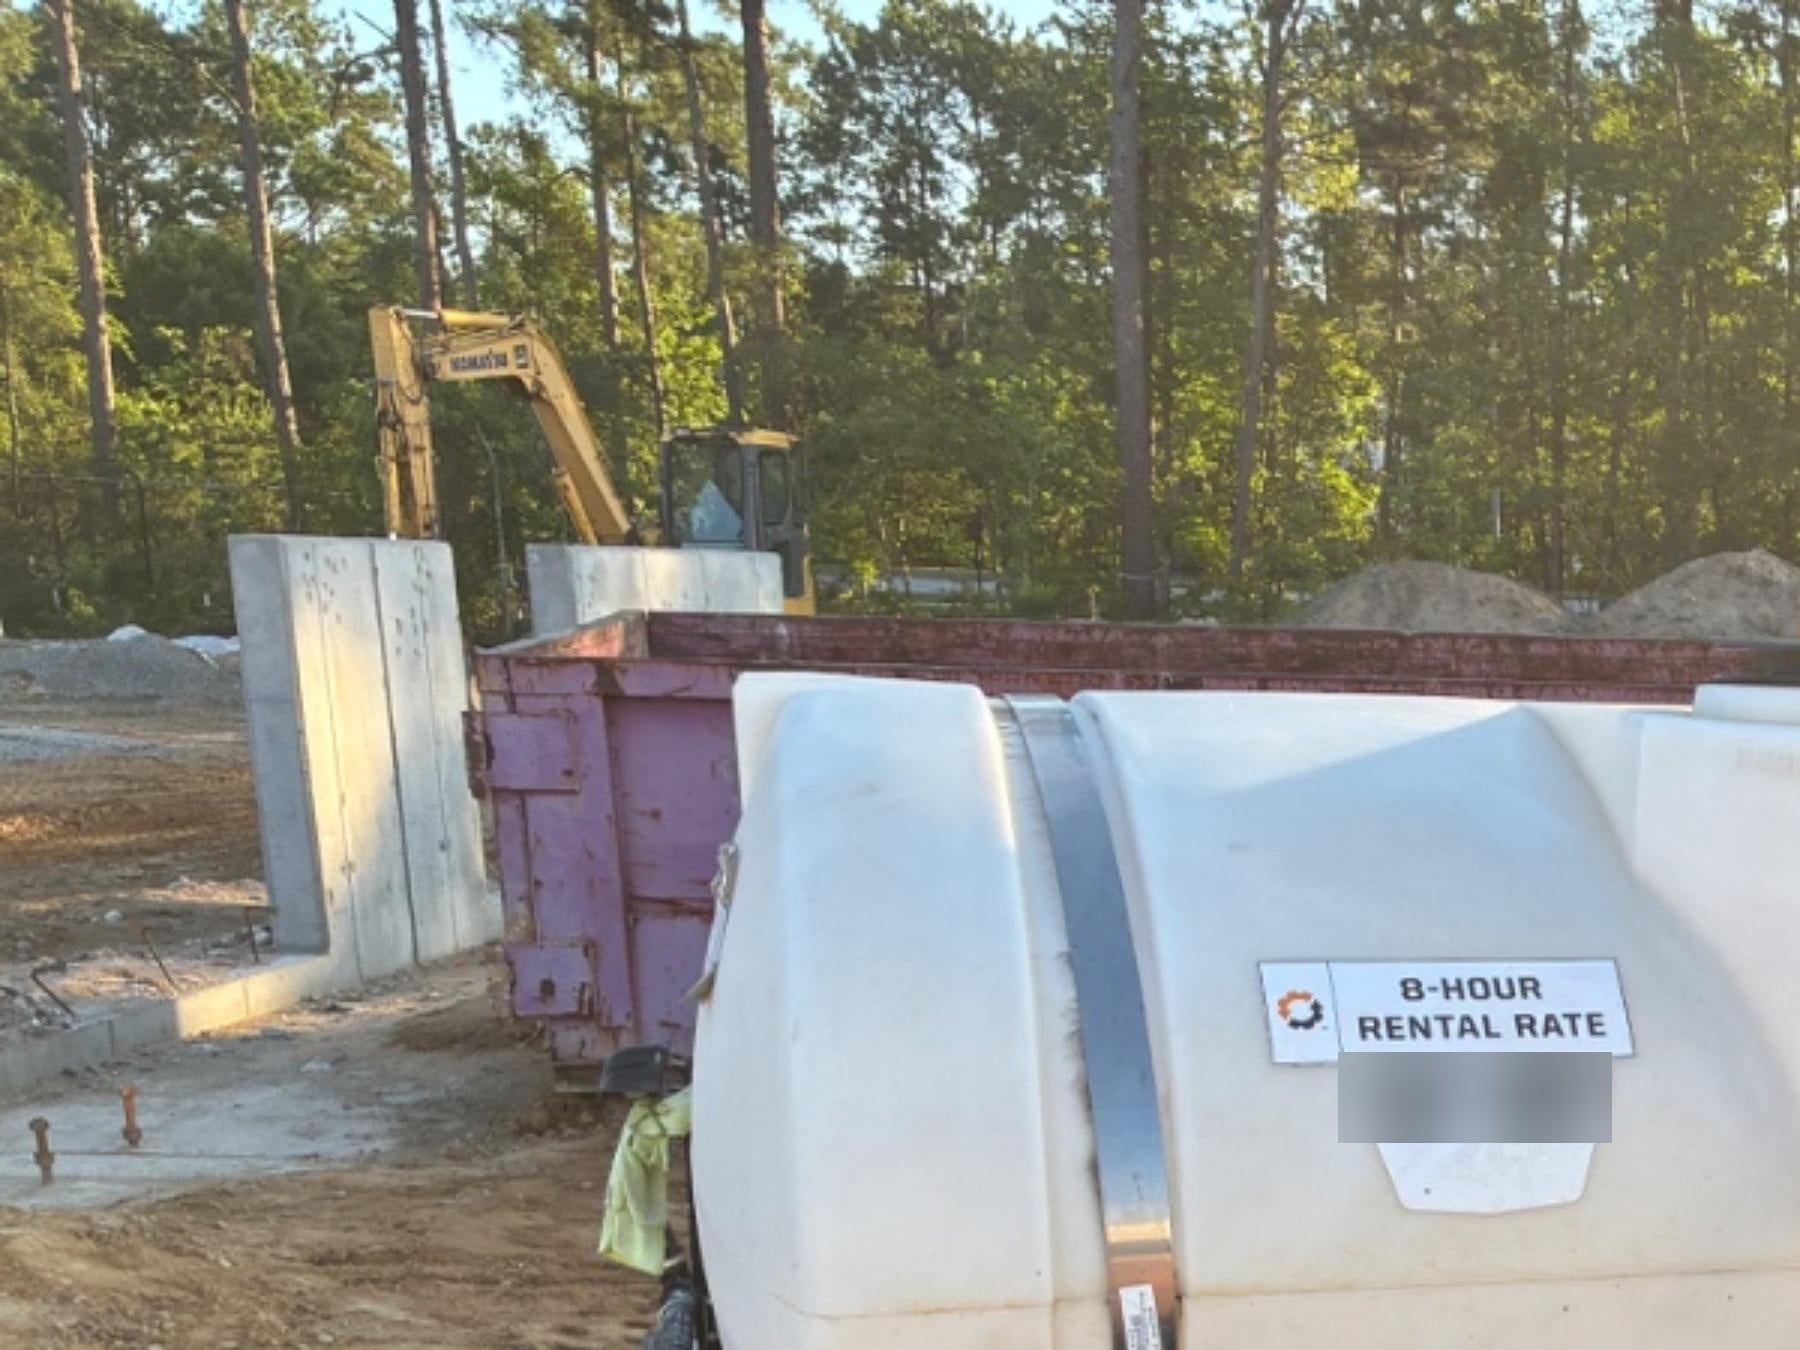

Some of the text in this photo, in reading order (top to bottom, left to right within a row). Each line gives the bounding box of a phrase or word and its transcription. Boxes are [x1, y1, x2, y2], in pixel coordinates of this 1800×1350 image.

[1400, 976, 1542, 1001] 8-HOUR
[1358, 1012, 1607, 1040] RENTAL RATE
